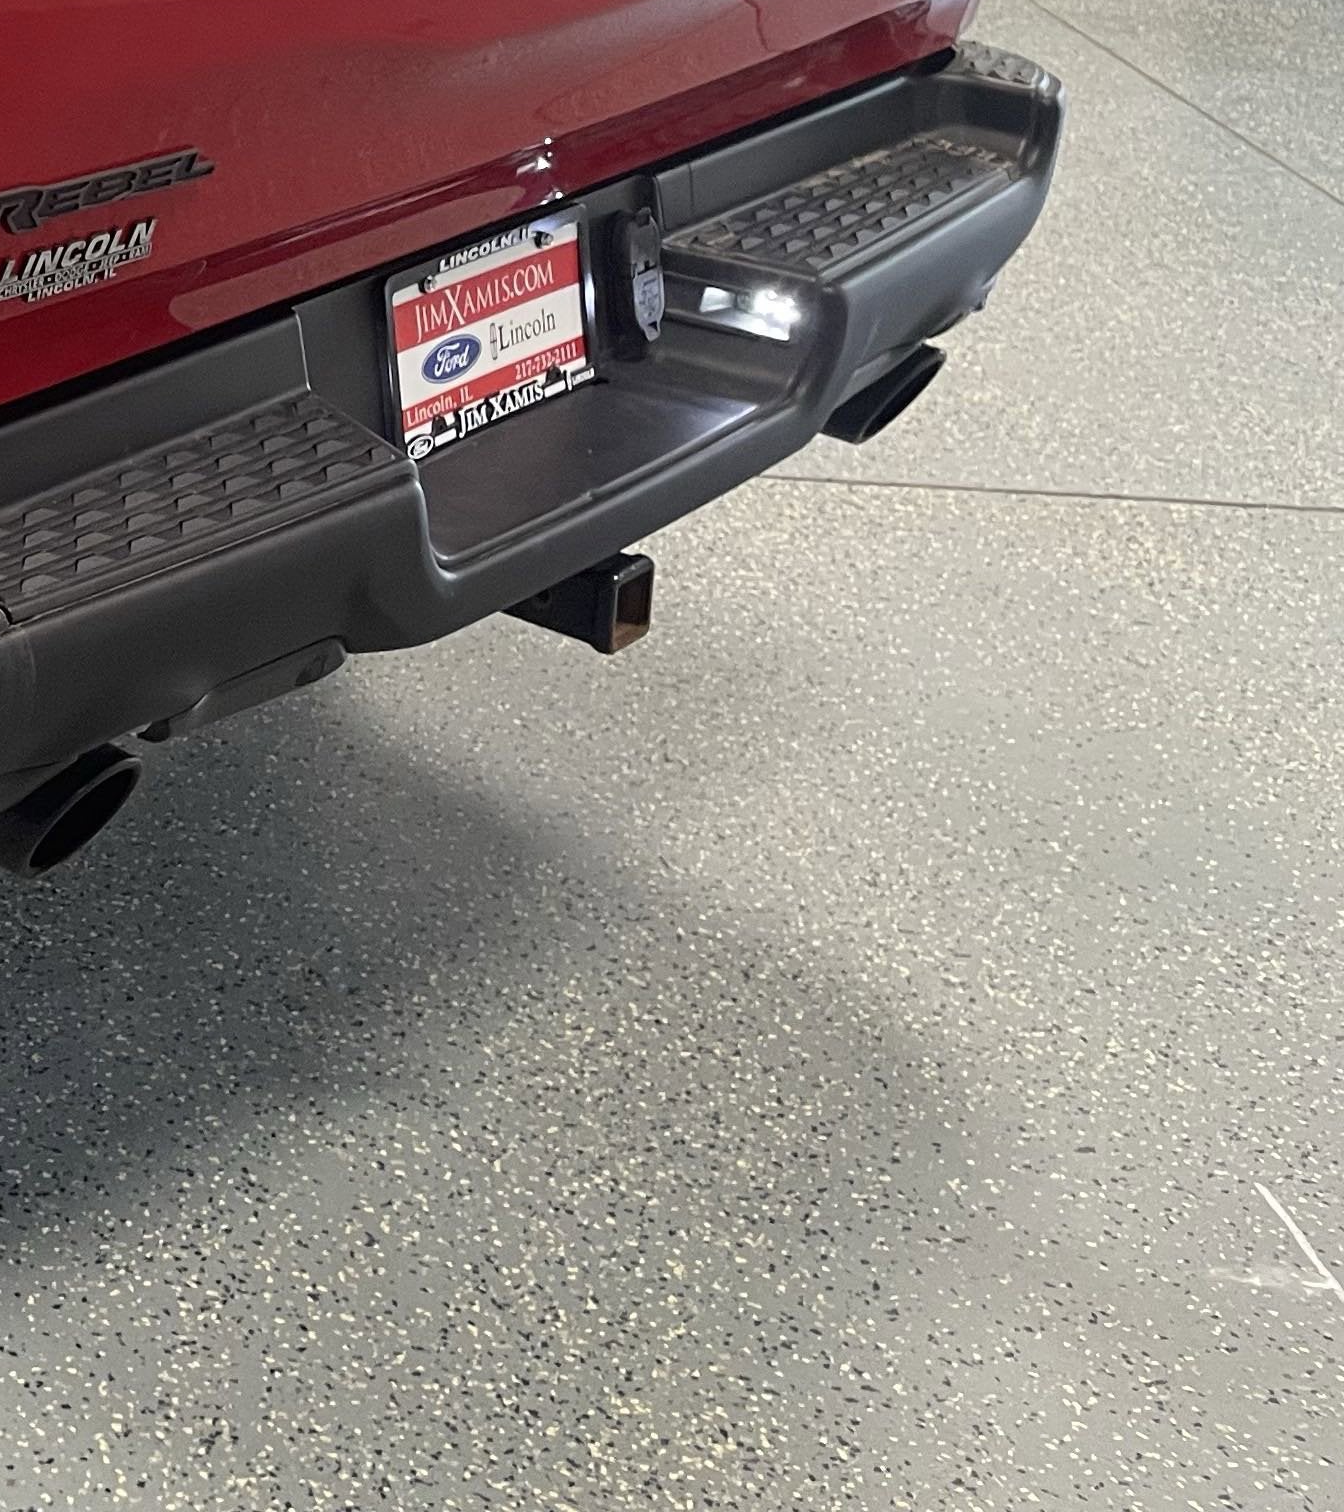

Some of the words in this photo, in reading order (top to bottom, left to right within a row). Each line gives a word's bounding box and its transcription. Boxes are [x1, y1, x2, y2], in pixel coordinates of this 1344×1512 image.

[415, 260, 554, 344] JIMXAMIS.COM
[434, 343, 470, 377] Ford
[499, 308, 557, 351] Lincoln
[458, 406, 488, 438] JIM
[491, 380, 544, 420] XAMIS
[461, 385, 474, 403] IL
